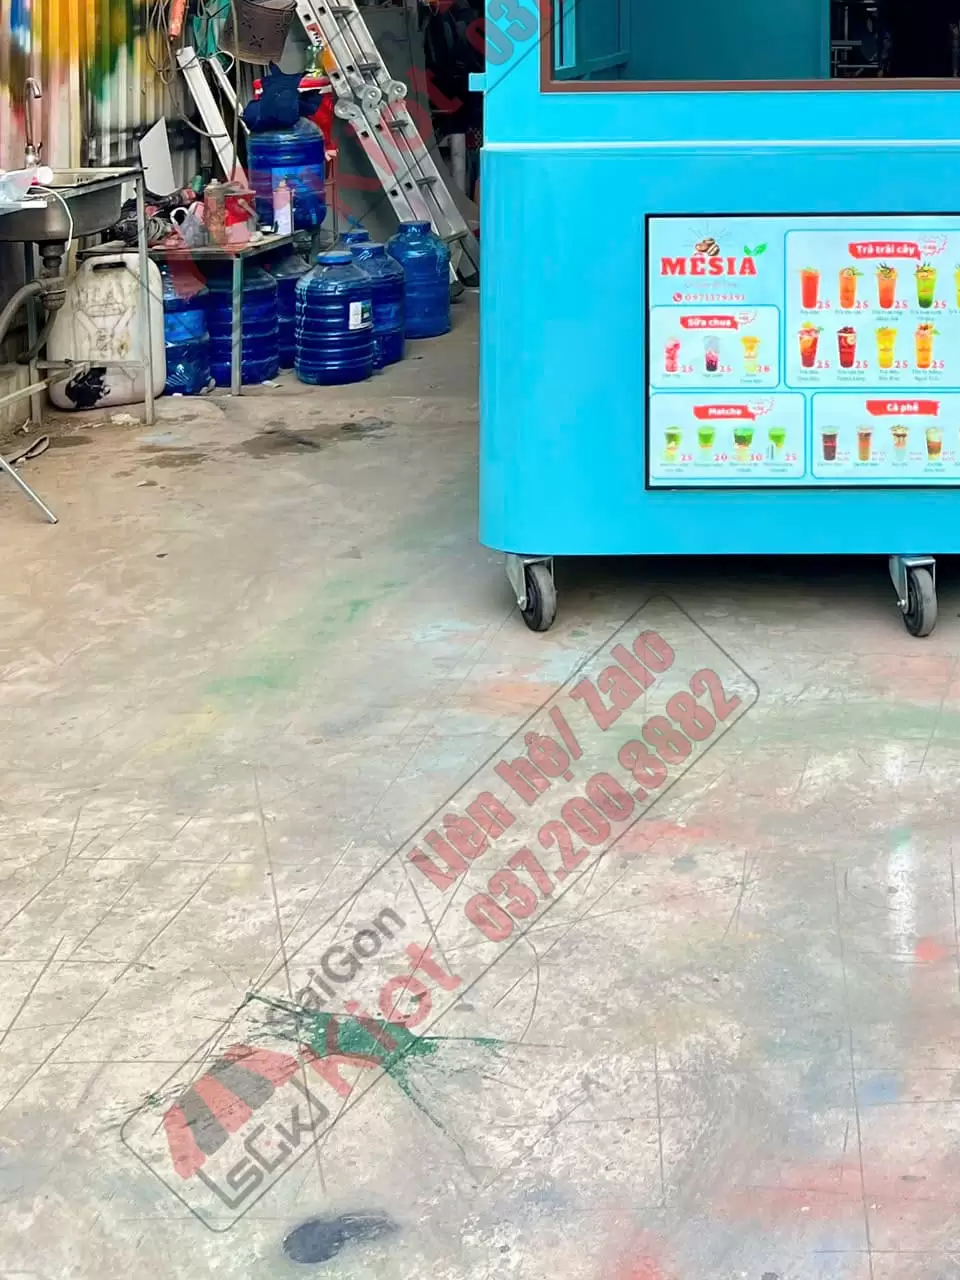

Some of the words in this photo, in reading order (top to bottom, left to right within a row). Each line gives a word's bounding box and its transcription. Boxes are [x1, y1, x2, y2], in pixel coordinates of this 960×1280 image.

[660, 252, 757, 276] MÊSIA
[817, 300, 831, 309] 25
[855, 300, 869, 309] 25
[894, 300, 908, 309] 25
[934, 300, 946, 309] 25
[817, 360, 830, 369] 25
[855, 360, 868, 369] 25
[894, 360, 908, 369] 25
[932, 360, 945, 369] 25
